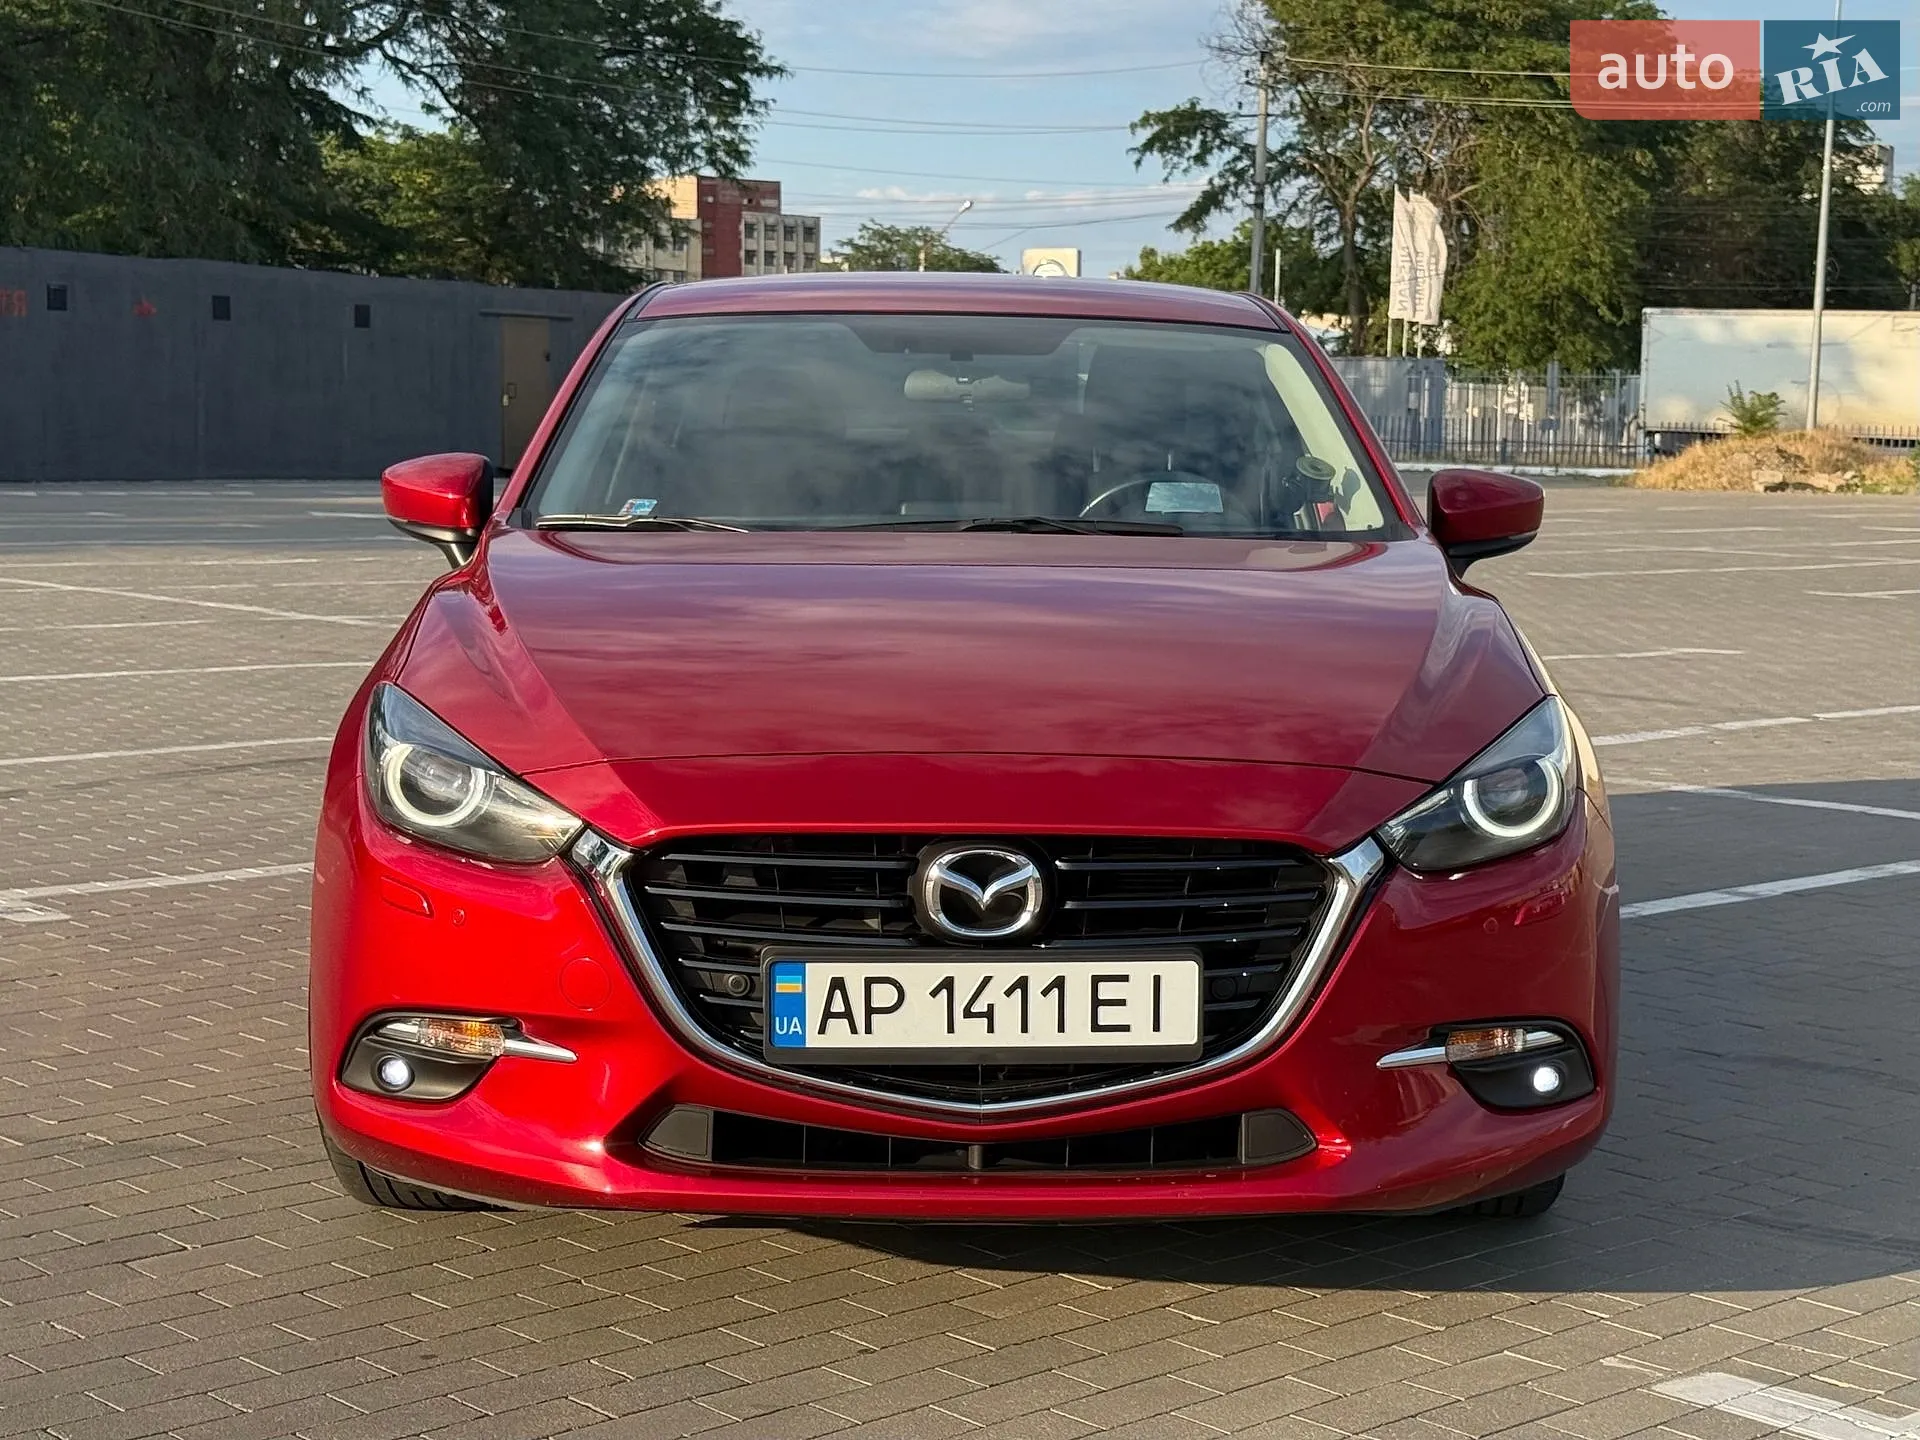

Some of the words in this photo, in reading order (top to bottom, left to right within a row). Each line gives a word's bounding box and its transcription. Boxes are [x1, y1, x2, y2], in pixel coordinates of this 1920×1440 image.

[817, 976, 905, 1035] AP
[929, 975, 1066, 1034] 1411
[1090, 974, 1161, 1033] EI
[775, 1016, 803, 1035] UA
